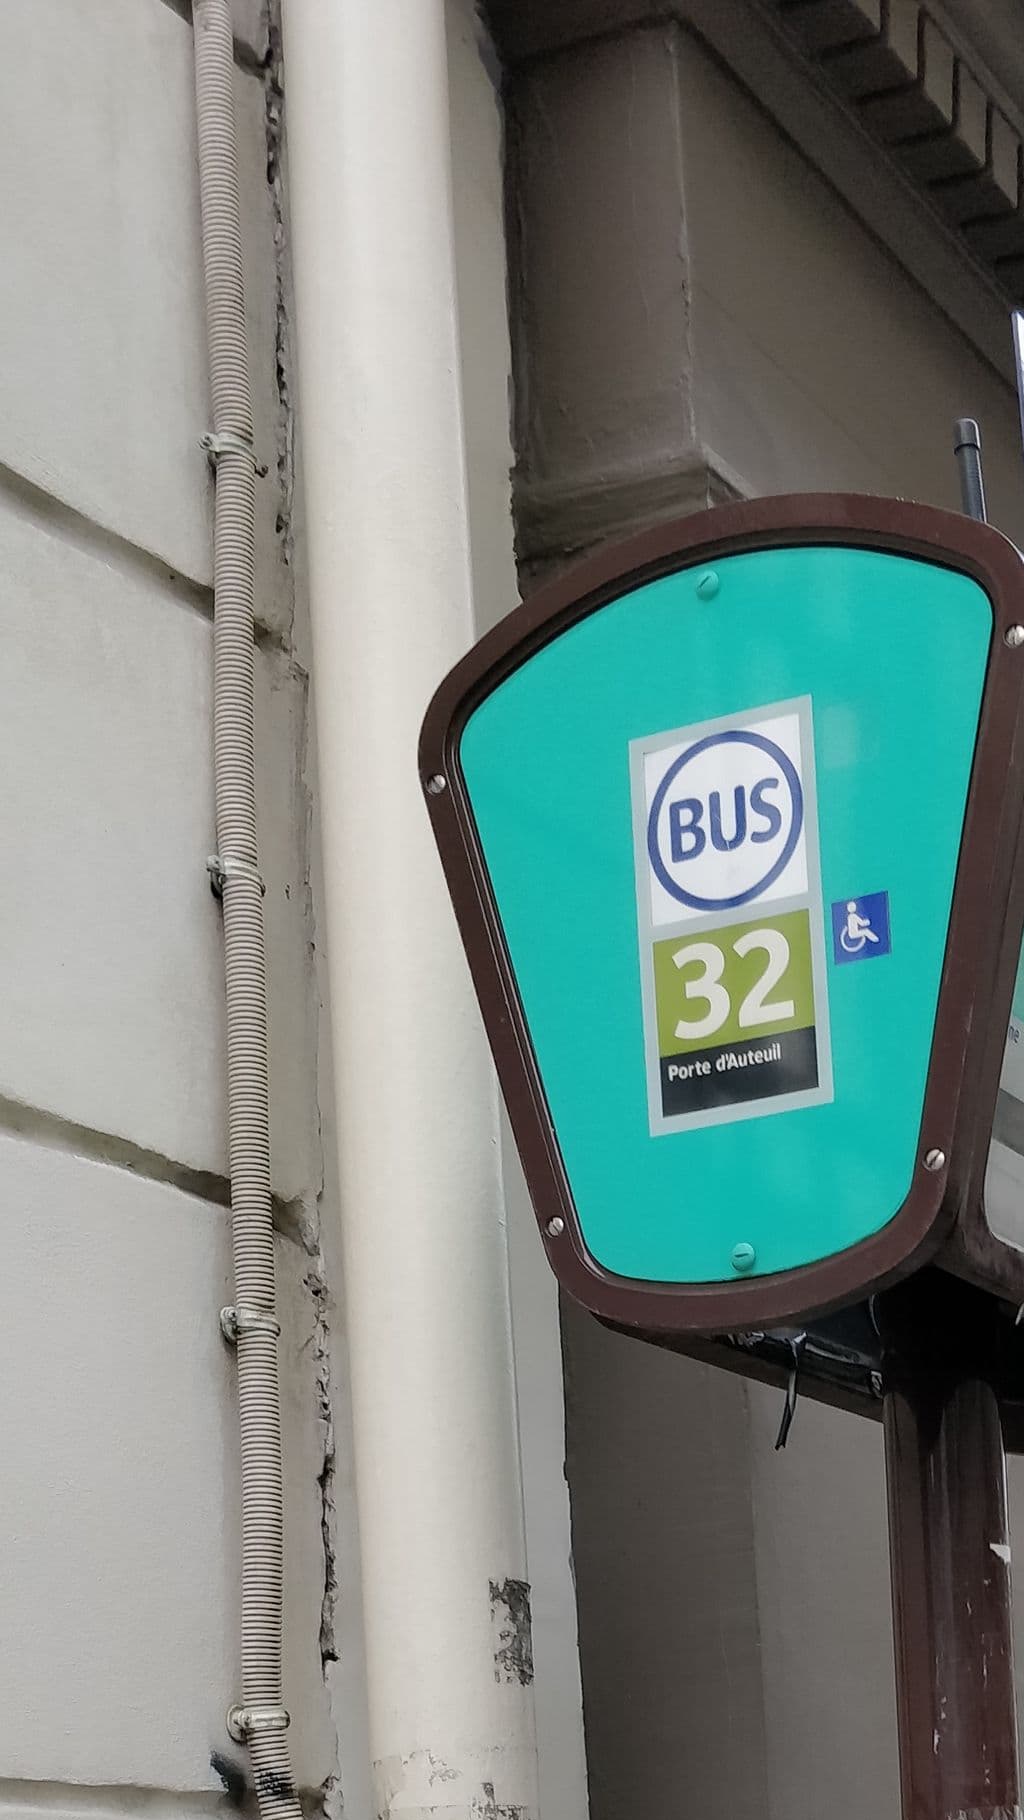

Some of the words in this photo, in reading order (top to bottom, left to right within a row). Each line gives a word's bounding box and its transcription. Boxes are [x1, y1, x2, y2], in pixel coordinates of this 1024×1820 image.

[669, 777, 783, 864] BUS
[672, 928, 795, 1041] 32
[667, 1055, 711, 1081] Porte
[715, 1042, 782, 1072] d'Auteuil
